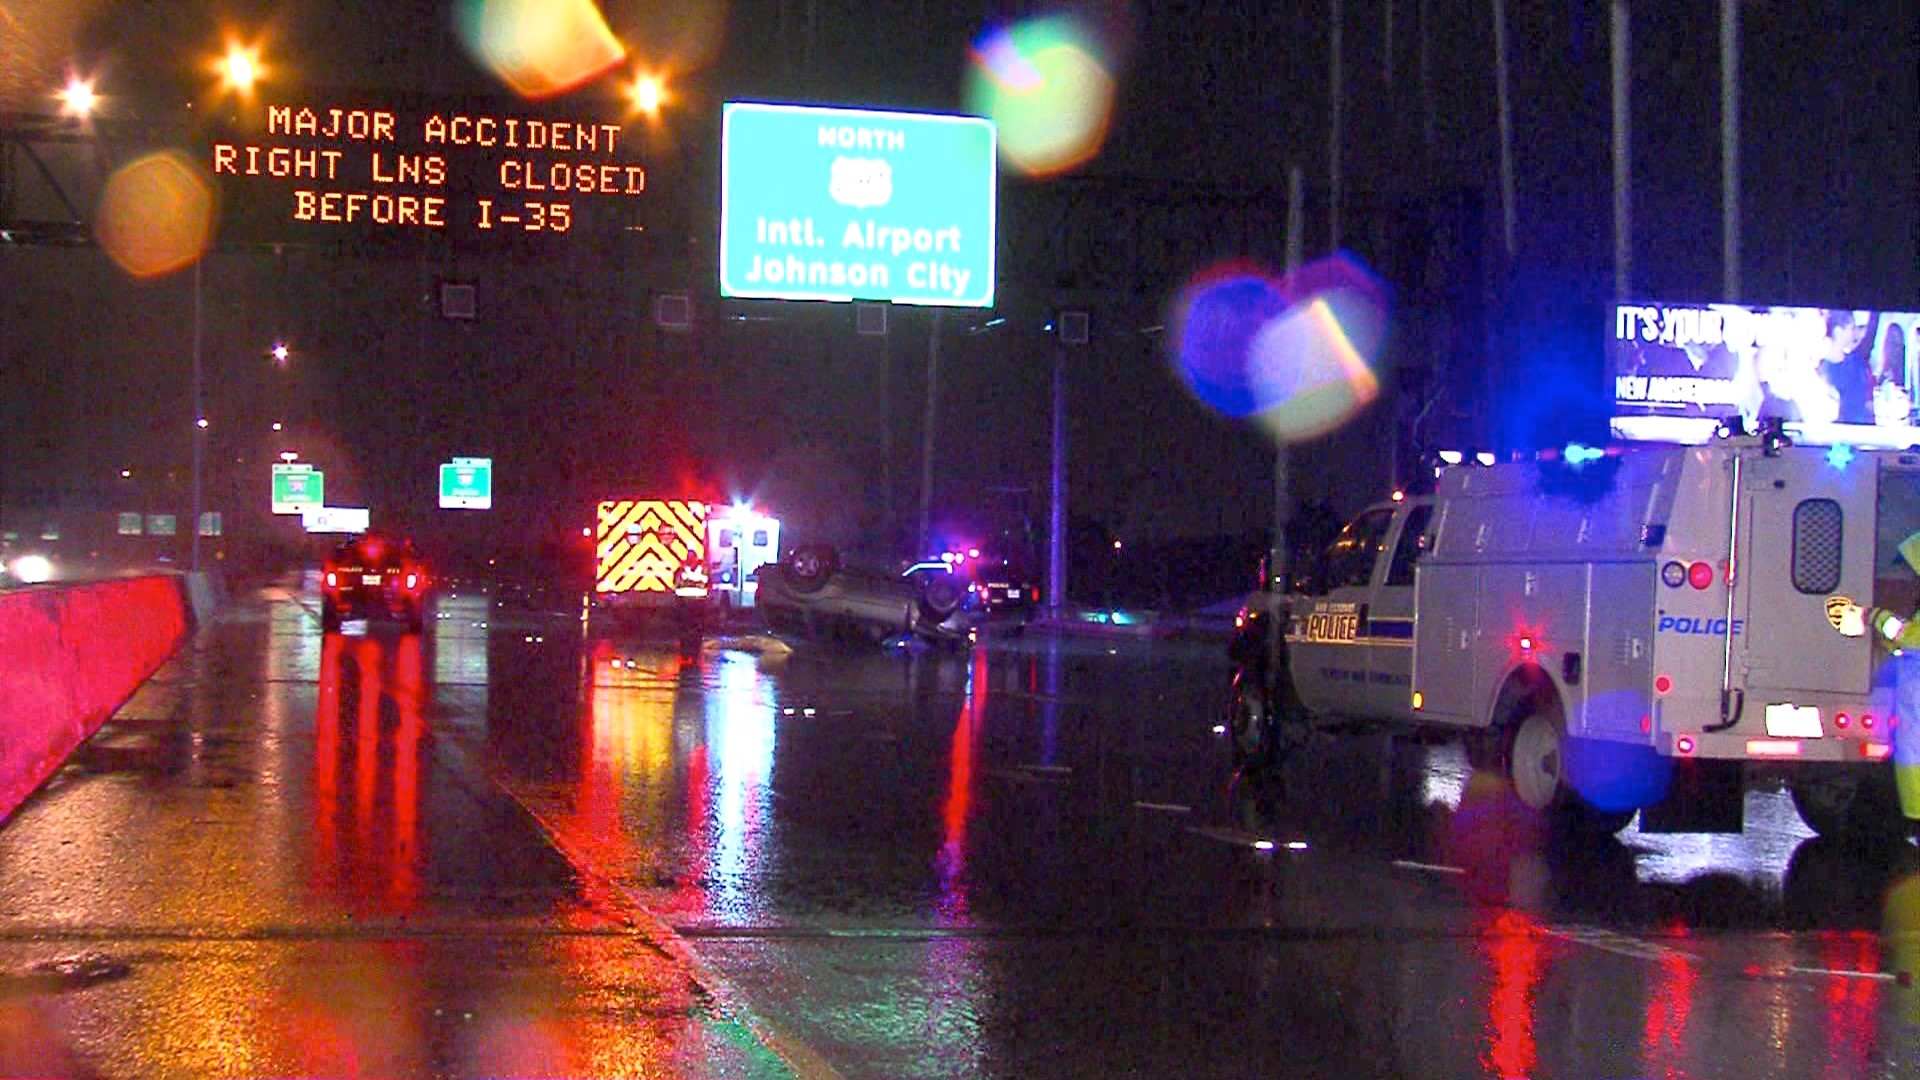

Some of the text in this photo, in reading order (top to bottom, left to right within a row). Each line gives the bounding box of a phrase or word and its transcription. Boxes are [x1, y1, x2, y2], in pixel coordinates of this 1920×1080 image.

[268, 106, 622, 153] MAJOR ACCIDENT
[817, 126, 905, 150] NORTH
[214, 144, 646, 195] RIGHT LNS CLOSED
[294, 190, 571, 232] BEFORE I-35
[757, 216, 962, 256] Intl. Airport
[744, 254, 971, 297] Johnson City
[1616, 306, 1658, 342] IT'S
[1309, 614, 1357, 640] POLICE
[1658, 616, 1744, 636] POLICE
